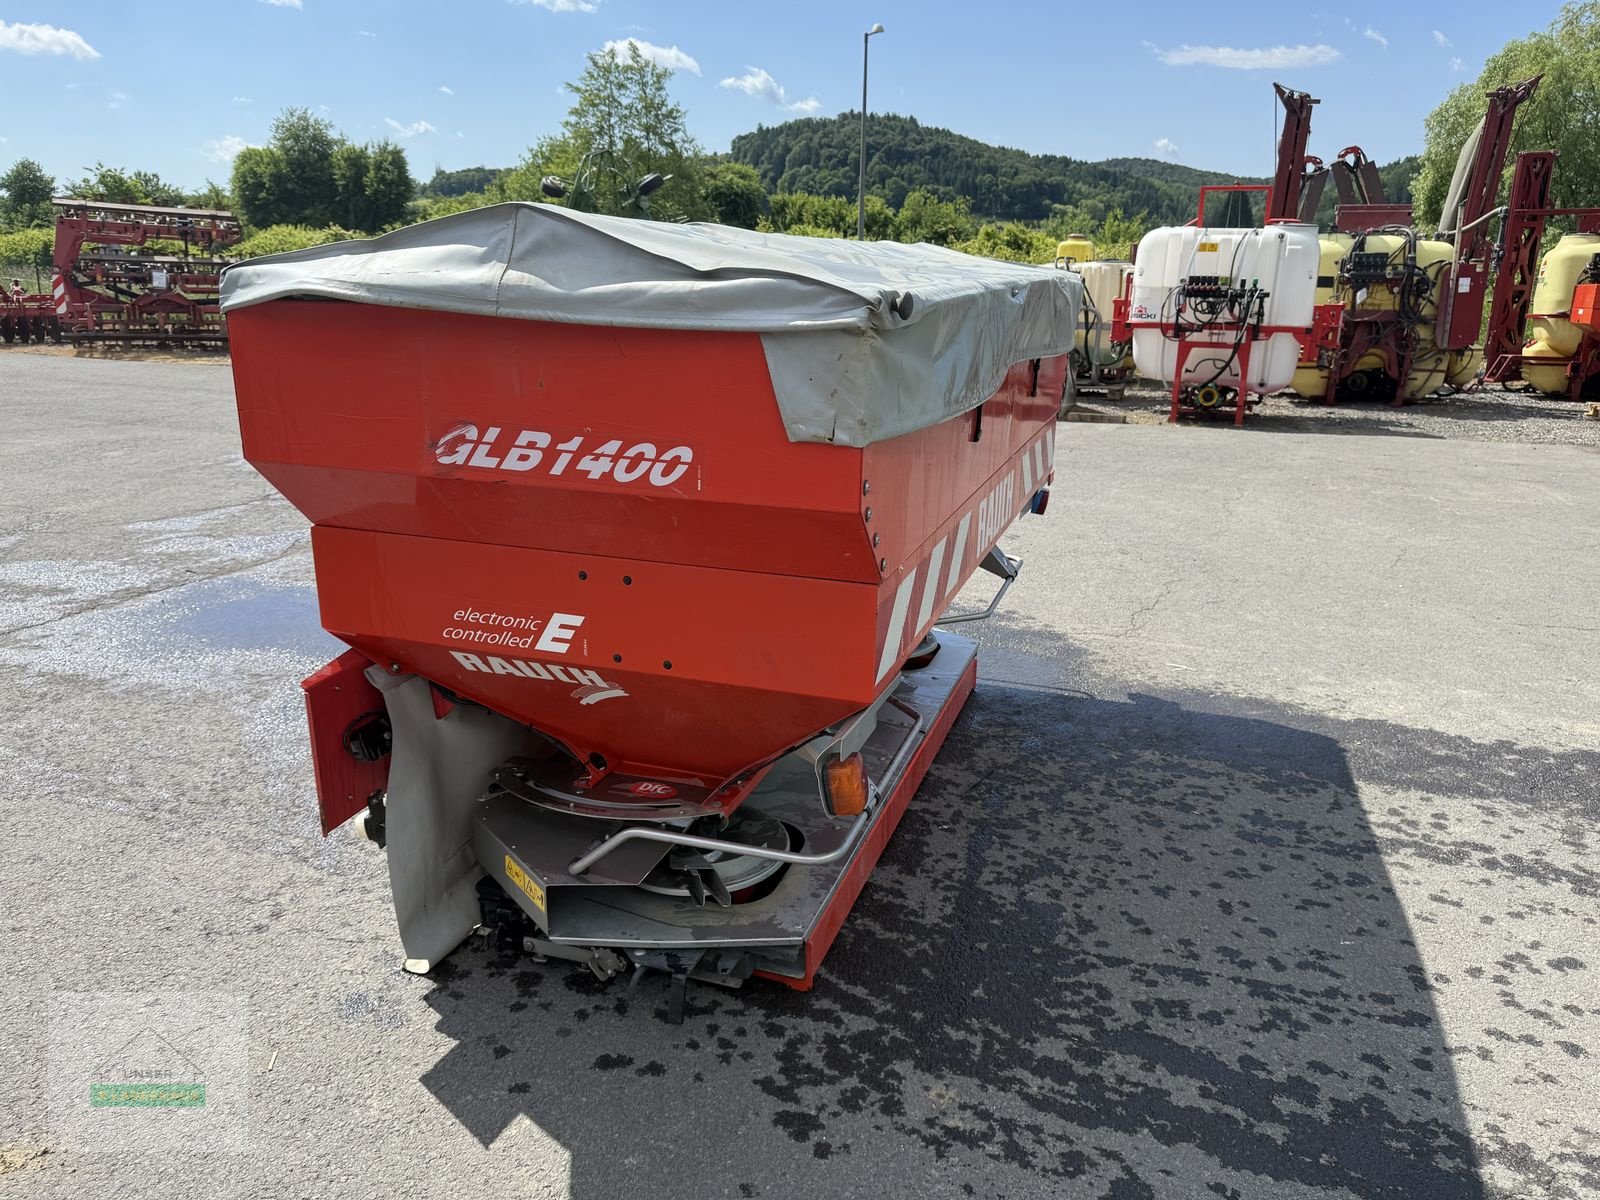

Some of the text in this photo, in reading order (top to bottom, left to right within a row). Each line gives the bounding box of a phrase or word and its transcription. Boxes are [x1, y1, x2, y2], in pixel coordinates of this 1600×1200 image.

[976, 469, 1015, 559] RAUCH
[442, 624, 534, 649] controlled
[453, 607, 542, 631] electronic
[533, 612, 586, 654] E
[449, 650, 610, 689] RAUCH
